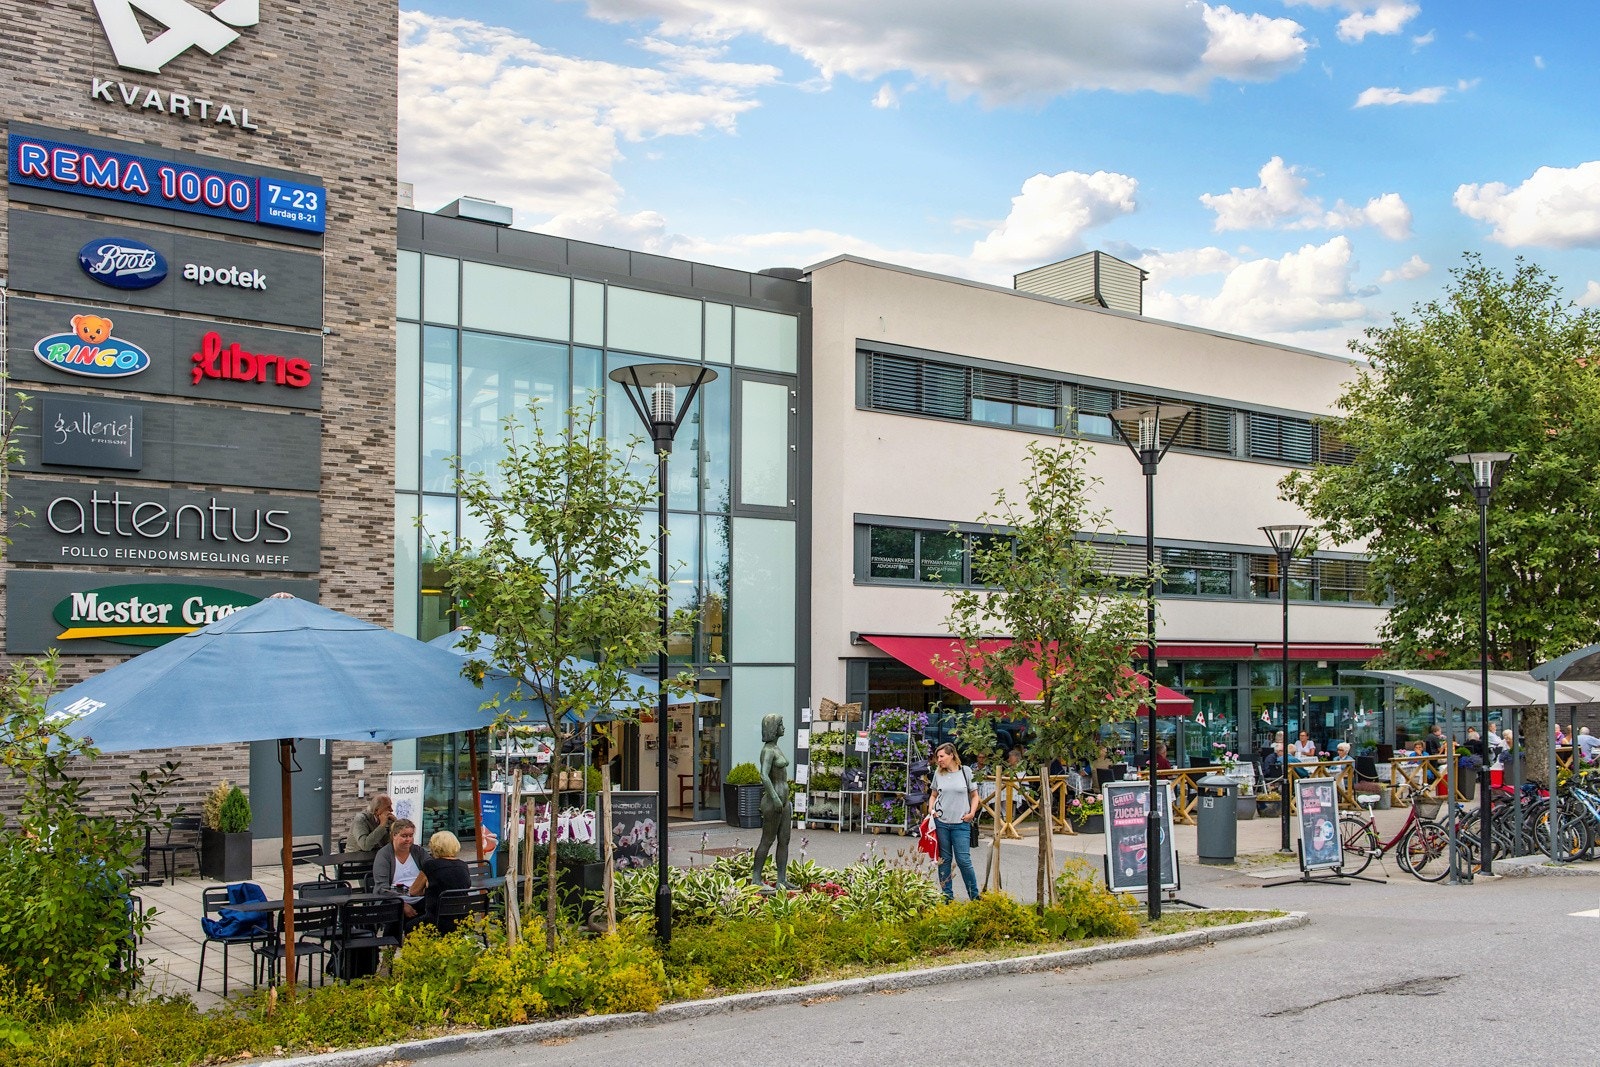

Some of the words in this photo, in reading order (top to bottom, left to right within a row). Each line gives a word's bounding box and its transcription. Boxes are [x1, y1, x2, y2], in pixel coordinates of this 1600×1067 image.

[91, 77, 259, 131] KVARTAL
[18, 141, 150, 195] REMA
[159, 166, 250, 211] 1000
[268, 184, 318, 211] 7-23
[269, 207, 296, 221] lørdag
[297, 211, 317, 223] 8-21
[89, 244, 157, 277] Boots
[183, 262, 267, 291] apotek
[47, 342, 139, 370] RINGO
[47, 489, 292, 544] attentus
[61, 546, 109, 558] FOLLO
[115, 548, 250, 564] EIENDOMSMEGLING
[255, 554, 290, 565] MEFF
[70, 592, 174, 625] Mester
